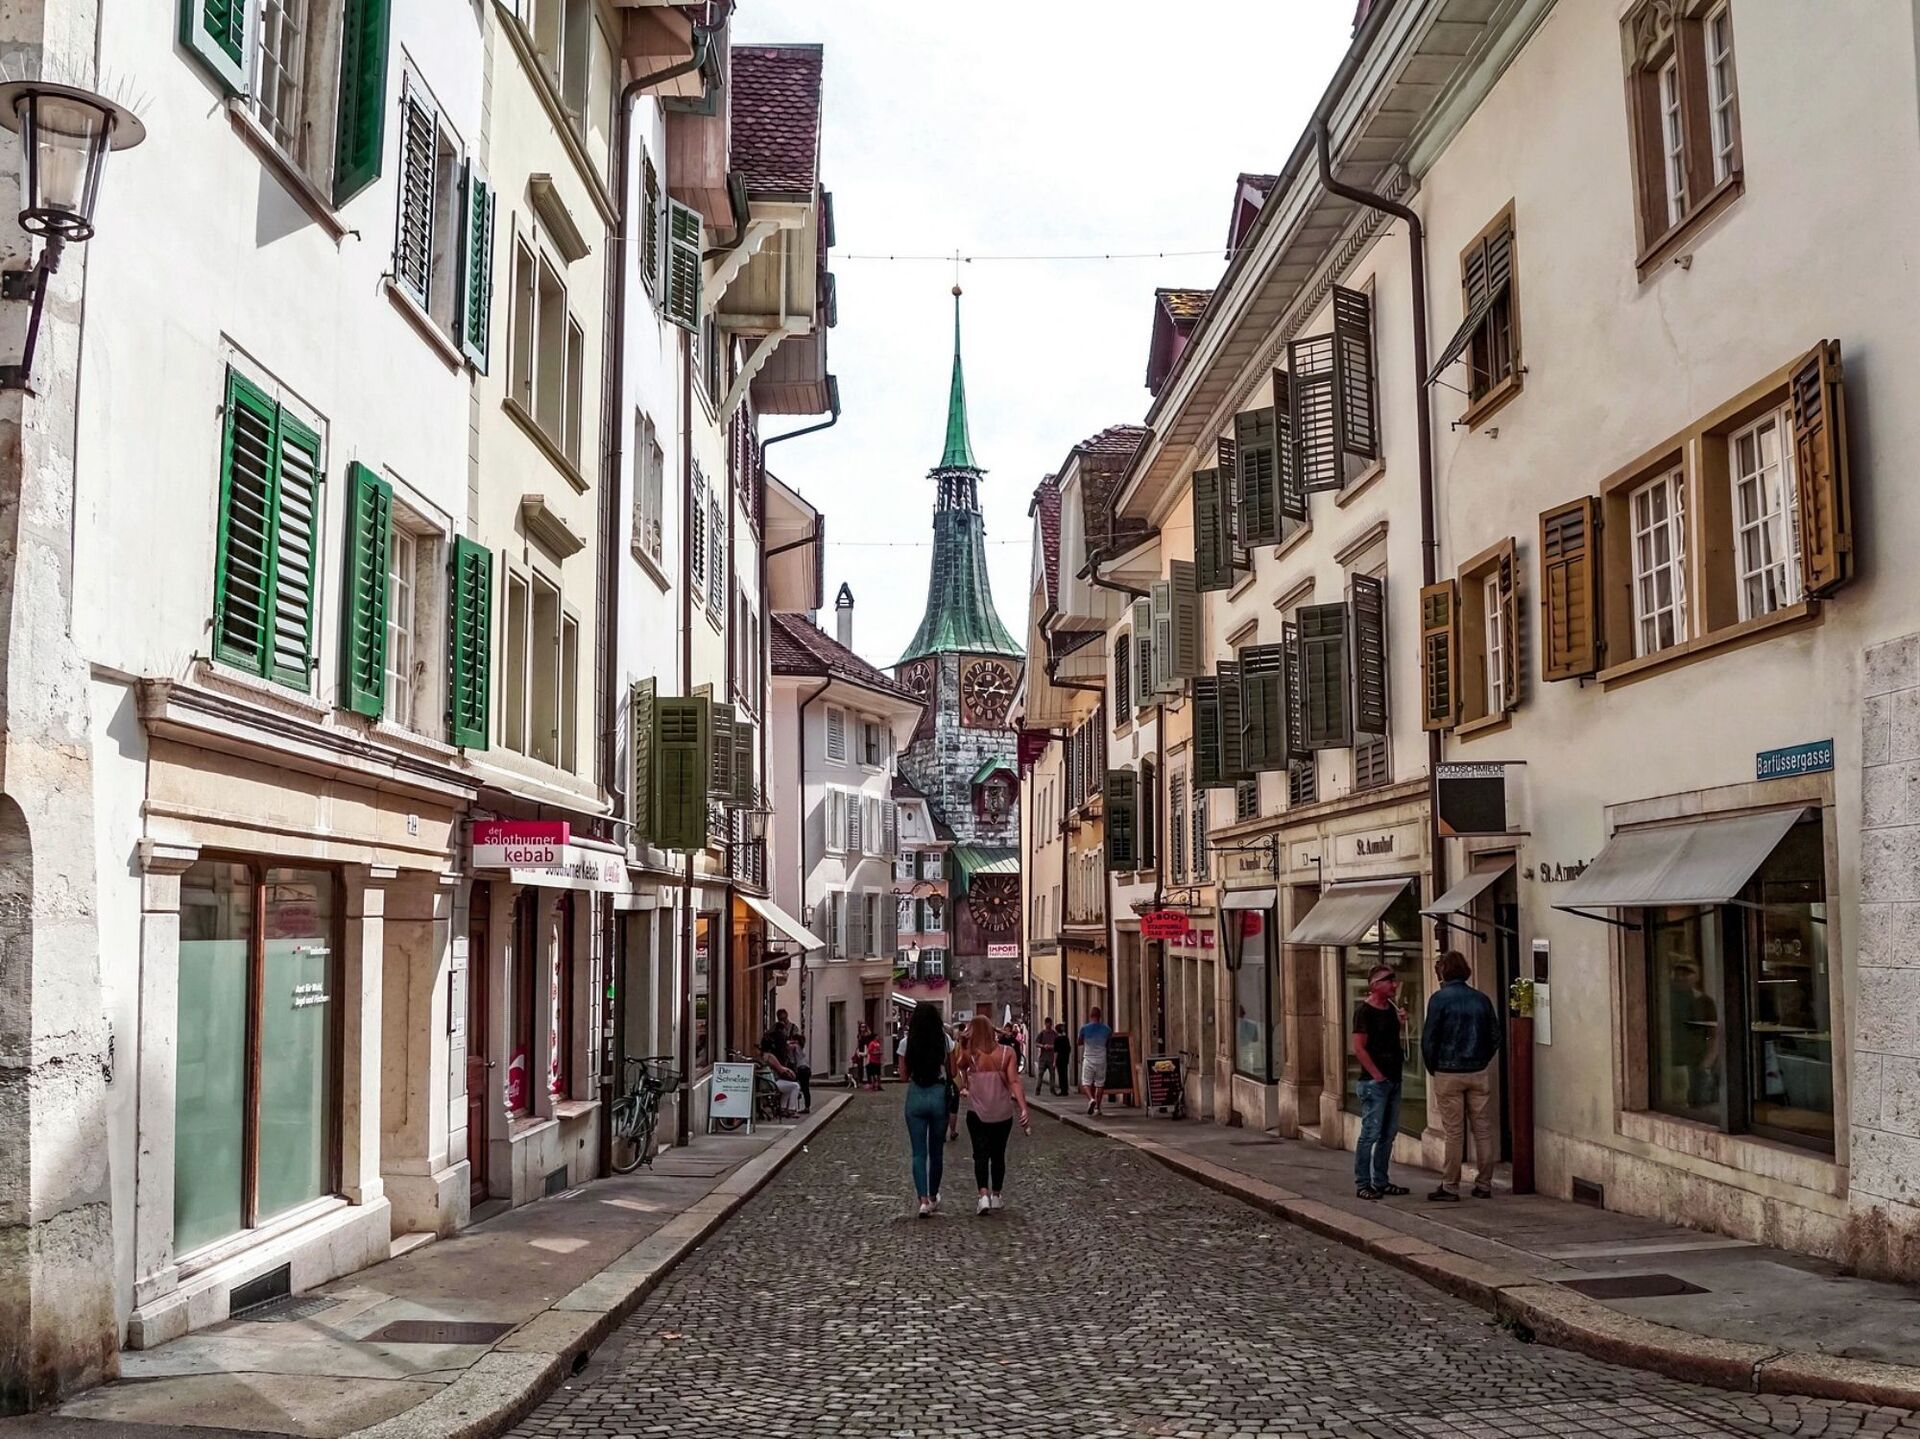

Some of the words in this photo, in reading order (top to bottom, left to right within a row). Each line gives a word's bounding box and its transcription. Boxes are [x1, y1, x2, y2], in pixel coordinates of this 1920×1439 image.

[1757, 749, 1830, 774] Barfüssergasse
[1437, 765, 1504, 774] GOLDSCHMIEDE
[488, 827, 502, 835] der
[484, 832, 555, 845] solothurner
[504, 847, 554, 862] kebab
[1145, 913, 1184, 924] U-BOOT
[990, 945, 1017, 953] IMPORT
